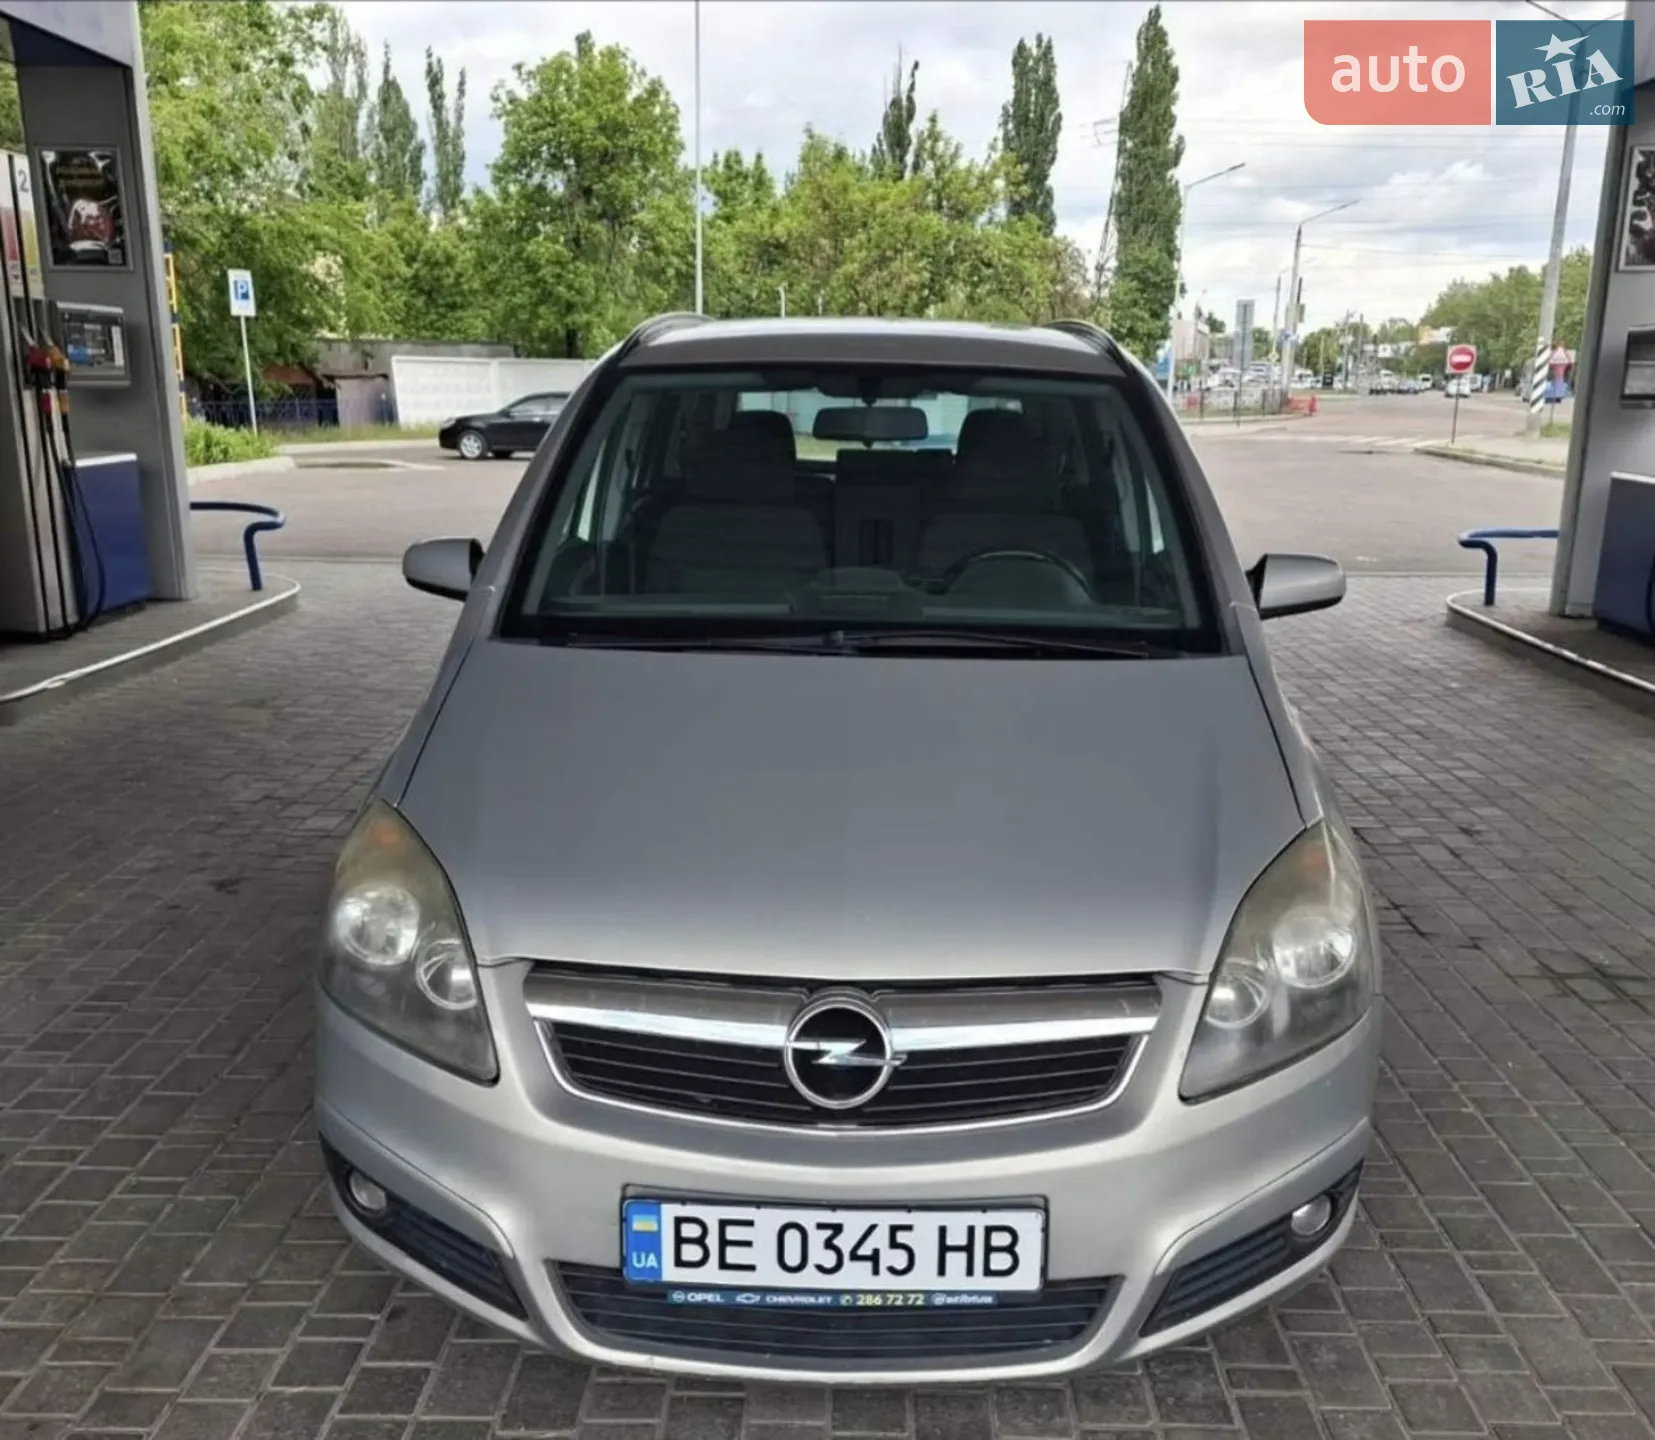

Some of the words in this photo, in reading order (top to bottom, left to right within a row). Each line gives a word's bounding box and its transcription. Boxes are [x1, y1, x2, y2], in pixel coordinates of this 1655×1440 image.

[17, 169, 30, 193] 2
[237, 281, 248, 300] P
[674, 1216, 757, 1272] BE
[776, 1221, 916, 1277] 0345
[937, 1225, 1020, 1277] HB
[632, 1252, 659, 1268] UA
[686, 1292, 725, 1303] OPEL
[886, 1294, 904, 1305] 72
[907, 1294, 925, 1305] 72
